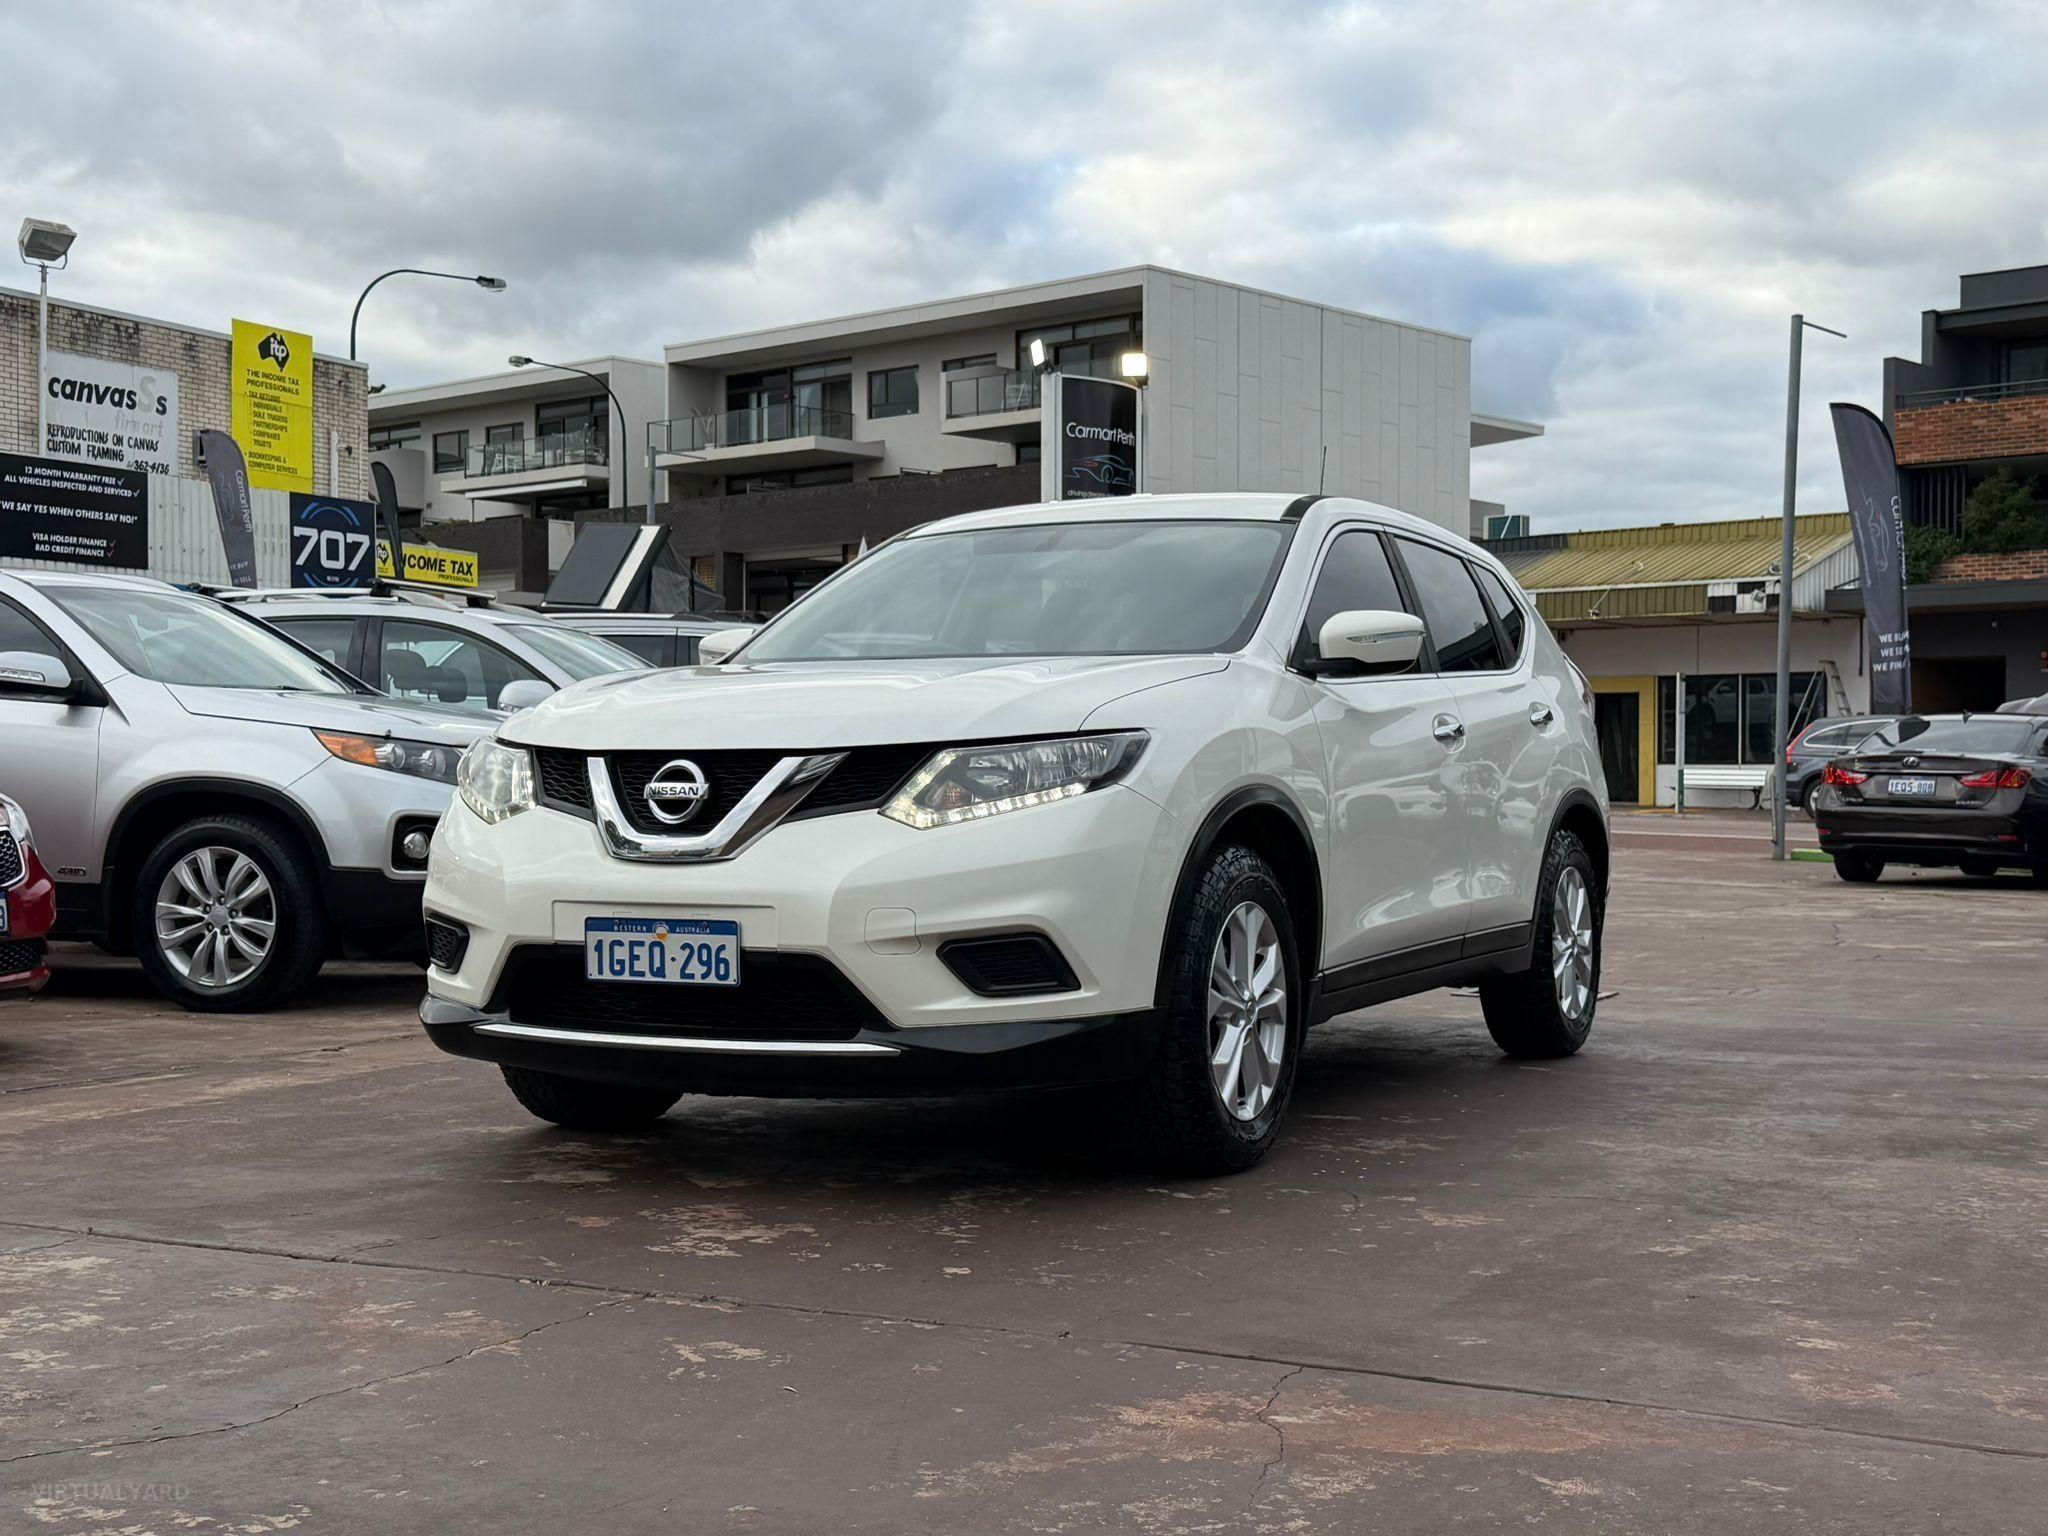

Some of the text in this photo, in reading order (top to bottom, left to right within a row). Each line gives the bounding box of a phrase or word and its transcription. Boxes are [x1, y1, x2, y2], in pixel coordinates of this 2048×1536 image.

[269, 336, 288, 362] itp
[246, 368, 300, 386] THE INCOME TAX
[246, 378, 300, 396] PROFESSIONALS
[248, 390, 258, 399] TAX
[252, 410, 289, 424] SOLE TRADERS
[46, 422, 160, 452] REPRODUCTIONS ON CANVAS
[252, 429, 281, 441] COMPANIES
[1066, 422, 1135, 447] Carmart Perth
[46, 438, 125, 463] CUSTOM FRAMING
[24, 465, 116, 486] 12 MONTH WARRANTY FREE
[248, 460, 299, 475] COMPUTER SERVICES
[4, 474, 133, 498] ALL VEHICLES INSPECTED AND SERVICED
[235, 468, 250, 512] Carmart
[16, 501, 32, 513] SAY
[33, 503, 48, 514] YES
[48, 505, 74, 517] WHEN
[75, 508, 104, 521] OTHERS
[104, 511, 119, 522] SAY
[32, 531, 107, 548] VISA HOLDER FINANCE
[35, 542, 105, 558] BAD CREDIT FINANCE
[293, 525, 371, 572] 707
[449, 559, 475, 577] TAX
[438, 573, 474, 584] PROFESSIONALS
[1879, 633, 1893, 643] WE
[1881, 646, 1894, 657] WE
[1872, 662, 1888, 672] WE
[649, 785, 699, 797] NISSAN
[613, 925, 711, 934] WESTERN AUSTRALIA
